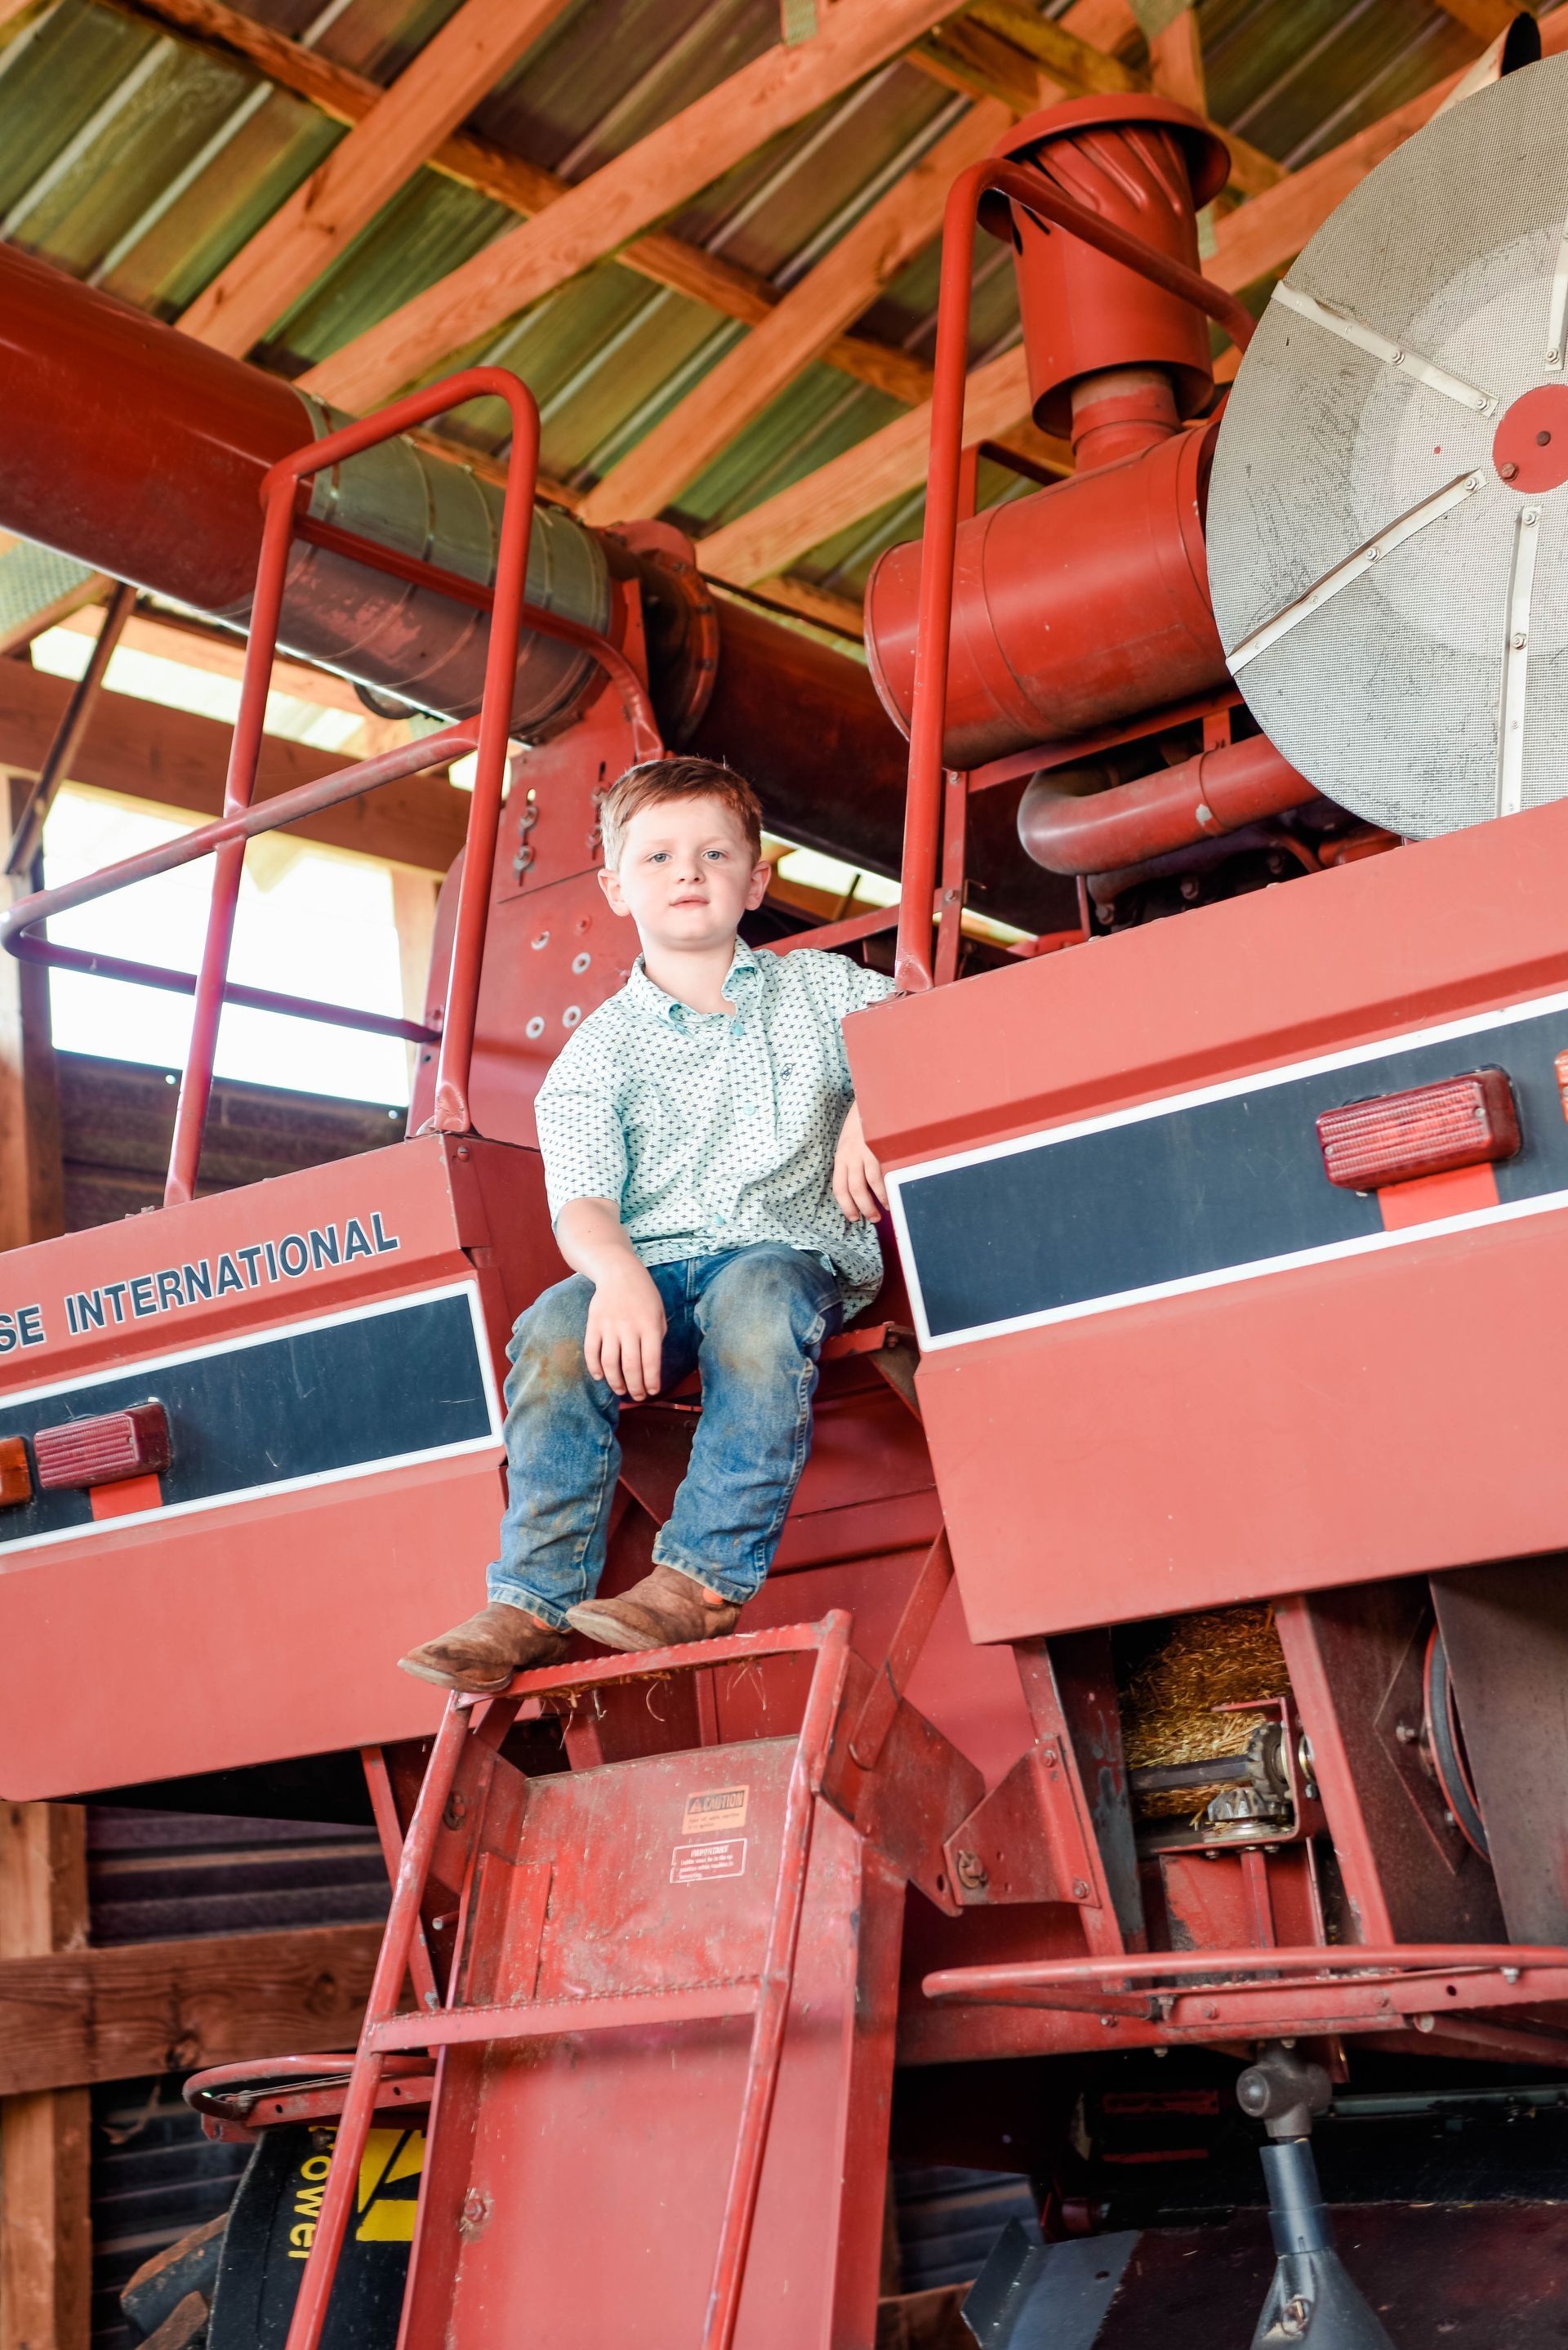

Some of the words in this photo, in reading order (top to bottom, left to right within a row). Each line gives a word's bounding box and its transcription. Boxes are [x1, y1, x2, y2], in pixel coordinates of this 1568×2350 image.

[0, 1304, 46, 1353] SE
[65, 1211, 400, 1336] INTERNATIONAL
[703, 1791, 744, 1811] CAUTION
[691, 1845, 729, 1857] IMPORTANT
[287, 2125, 338, 2259] owe
